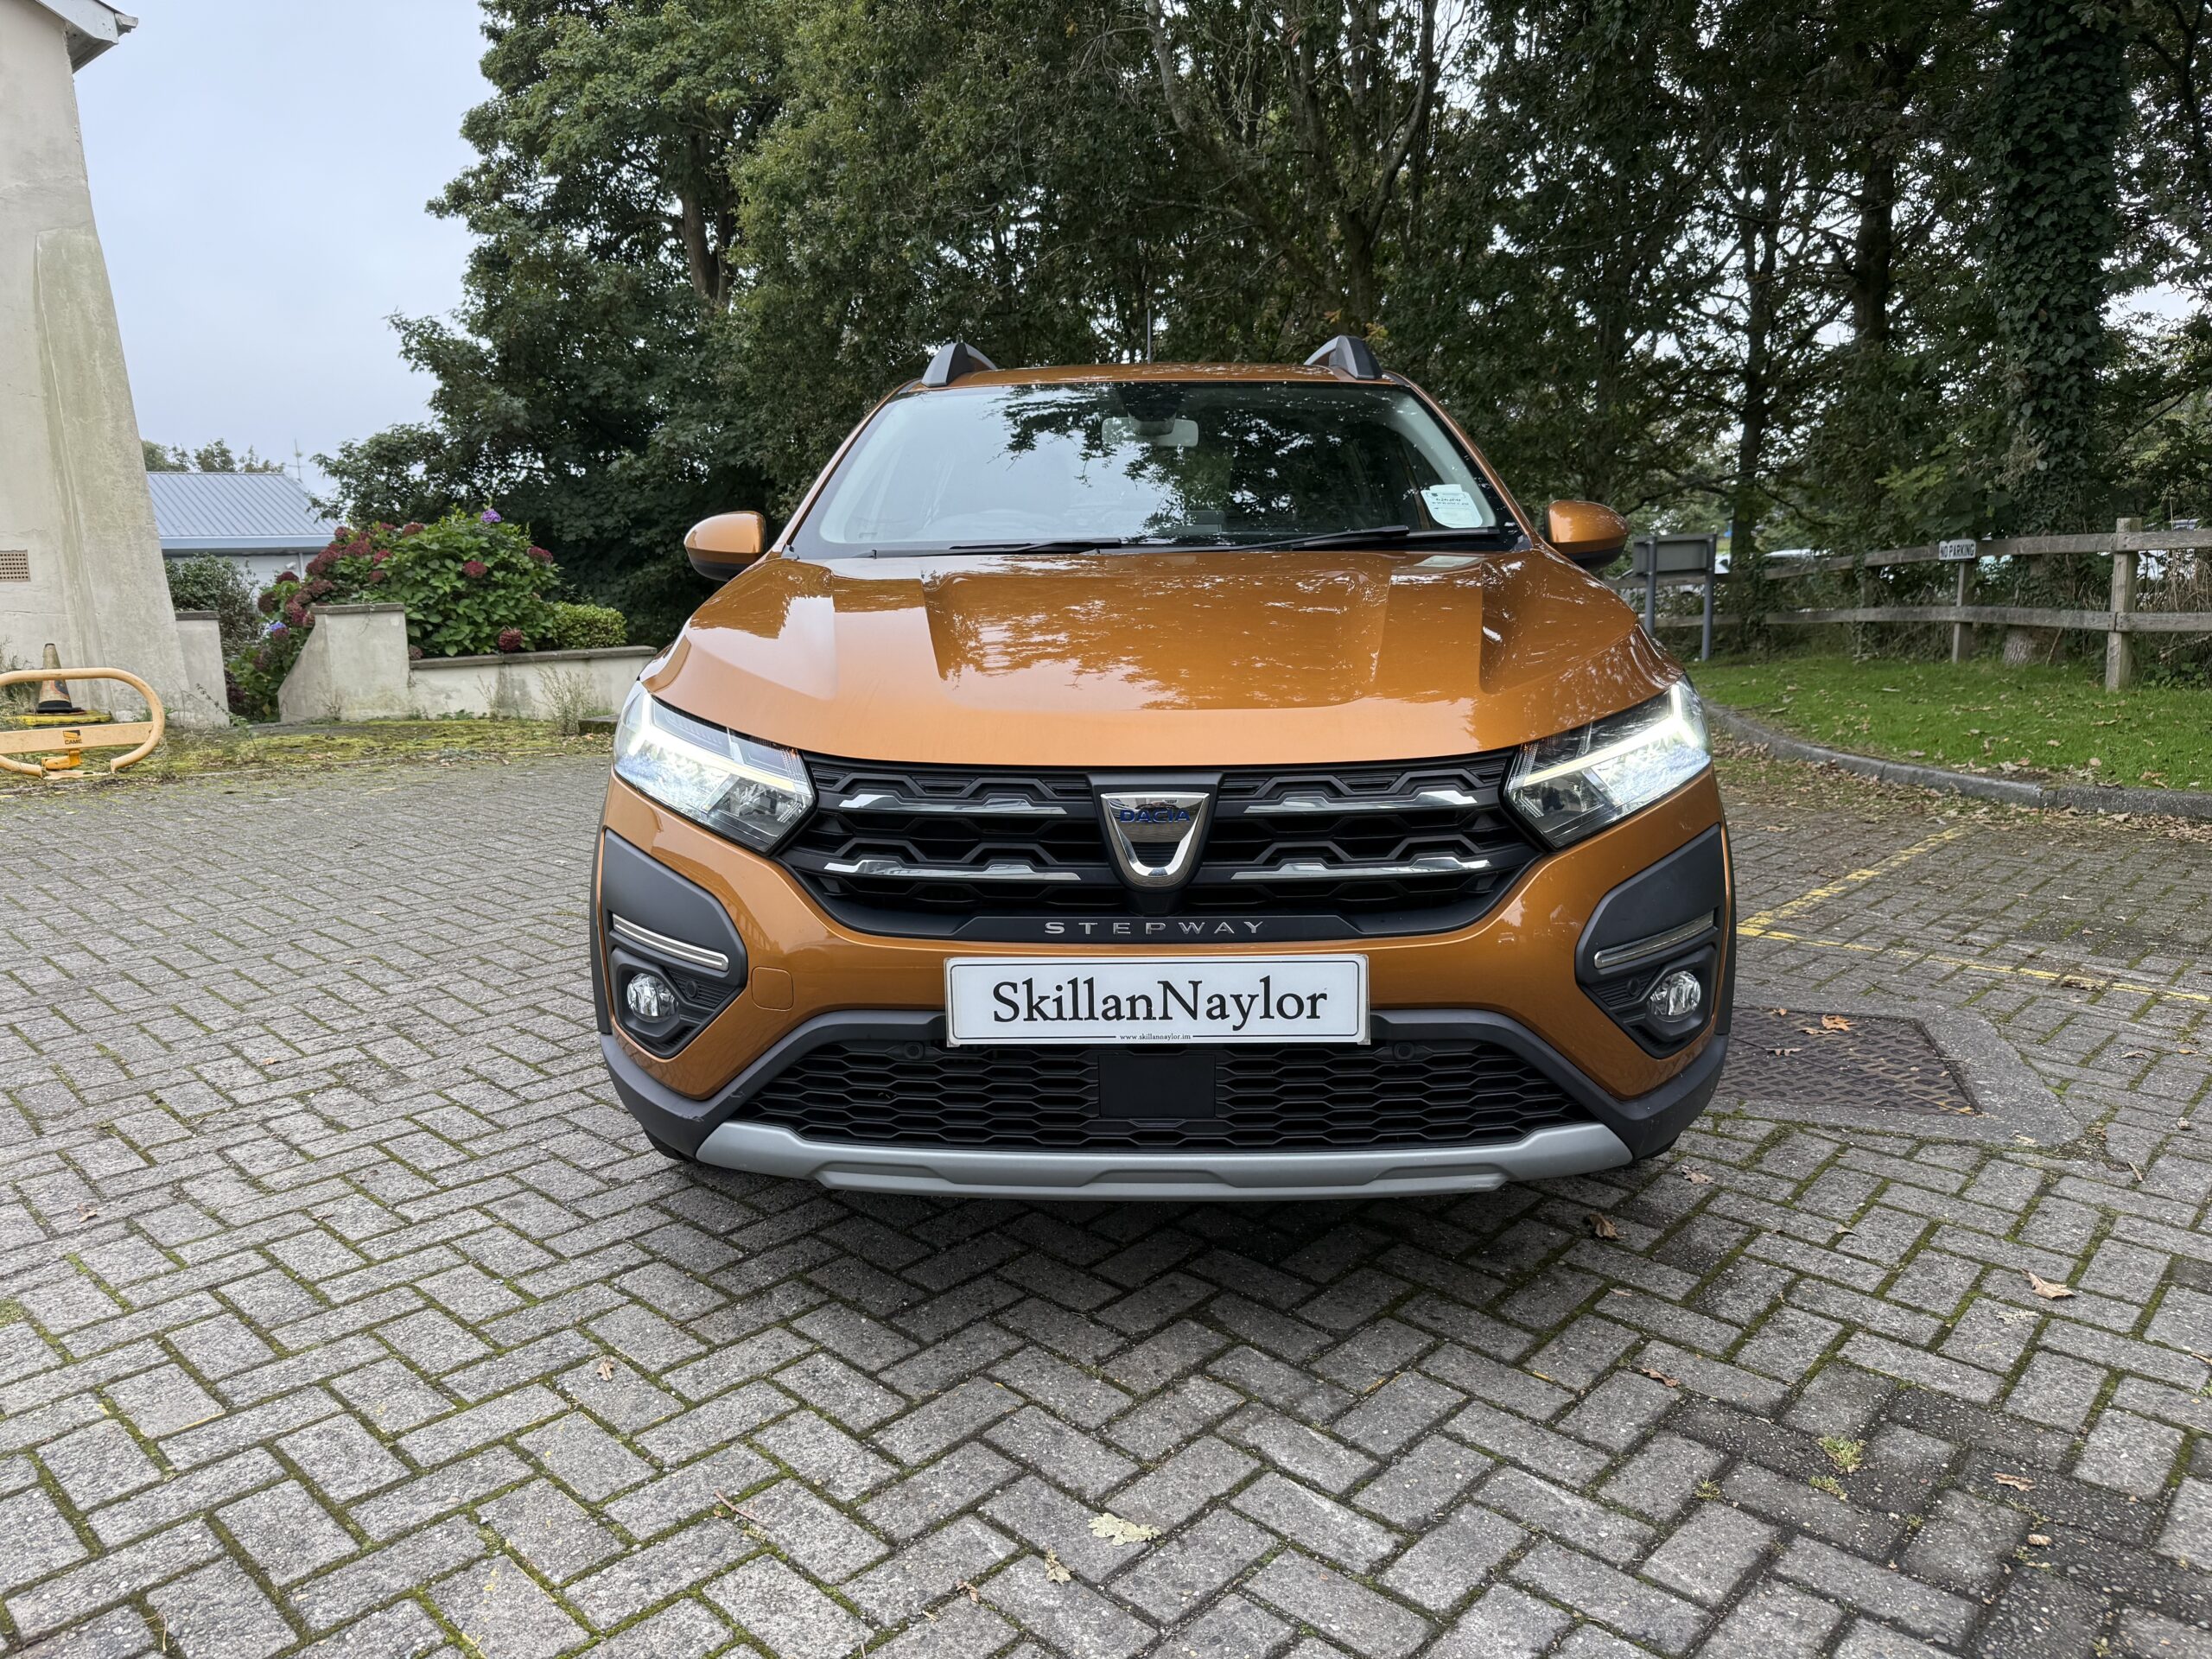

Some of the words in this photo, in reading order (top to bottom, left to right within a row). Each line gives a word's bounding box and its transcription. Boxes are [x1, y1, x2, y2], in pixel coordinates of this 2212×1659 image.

[1941, 545, 1948, 557] NO
[1949, 543, 1974, 556] PARKING
[1120, 809, 1191, 822] DACIA
[1044, 921, 1263, 935] STEPWAY
[993, 976, 1328, 1031] SkillanNaylor
[1120, 1033, 1191, 1041] www.skillannaylor.im
